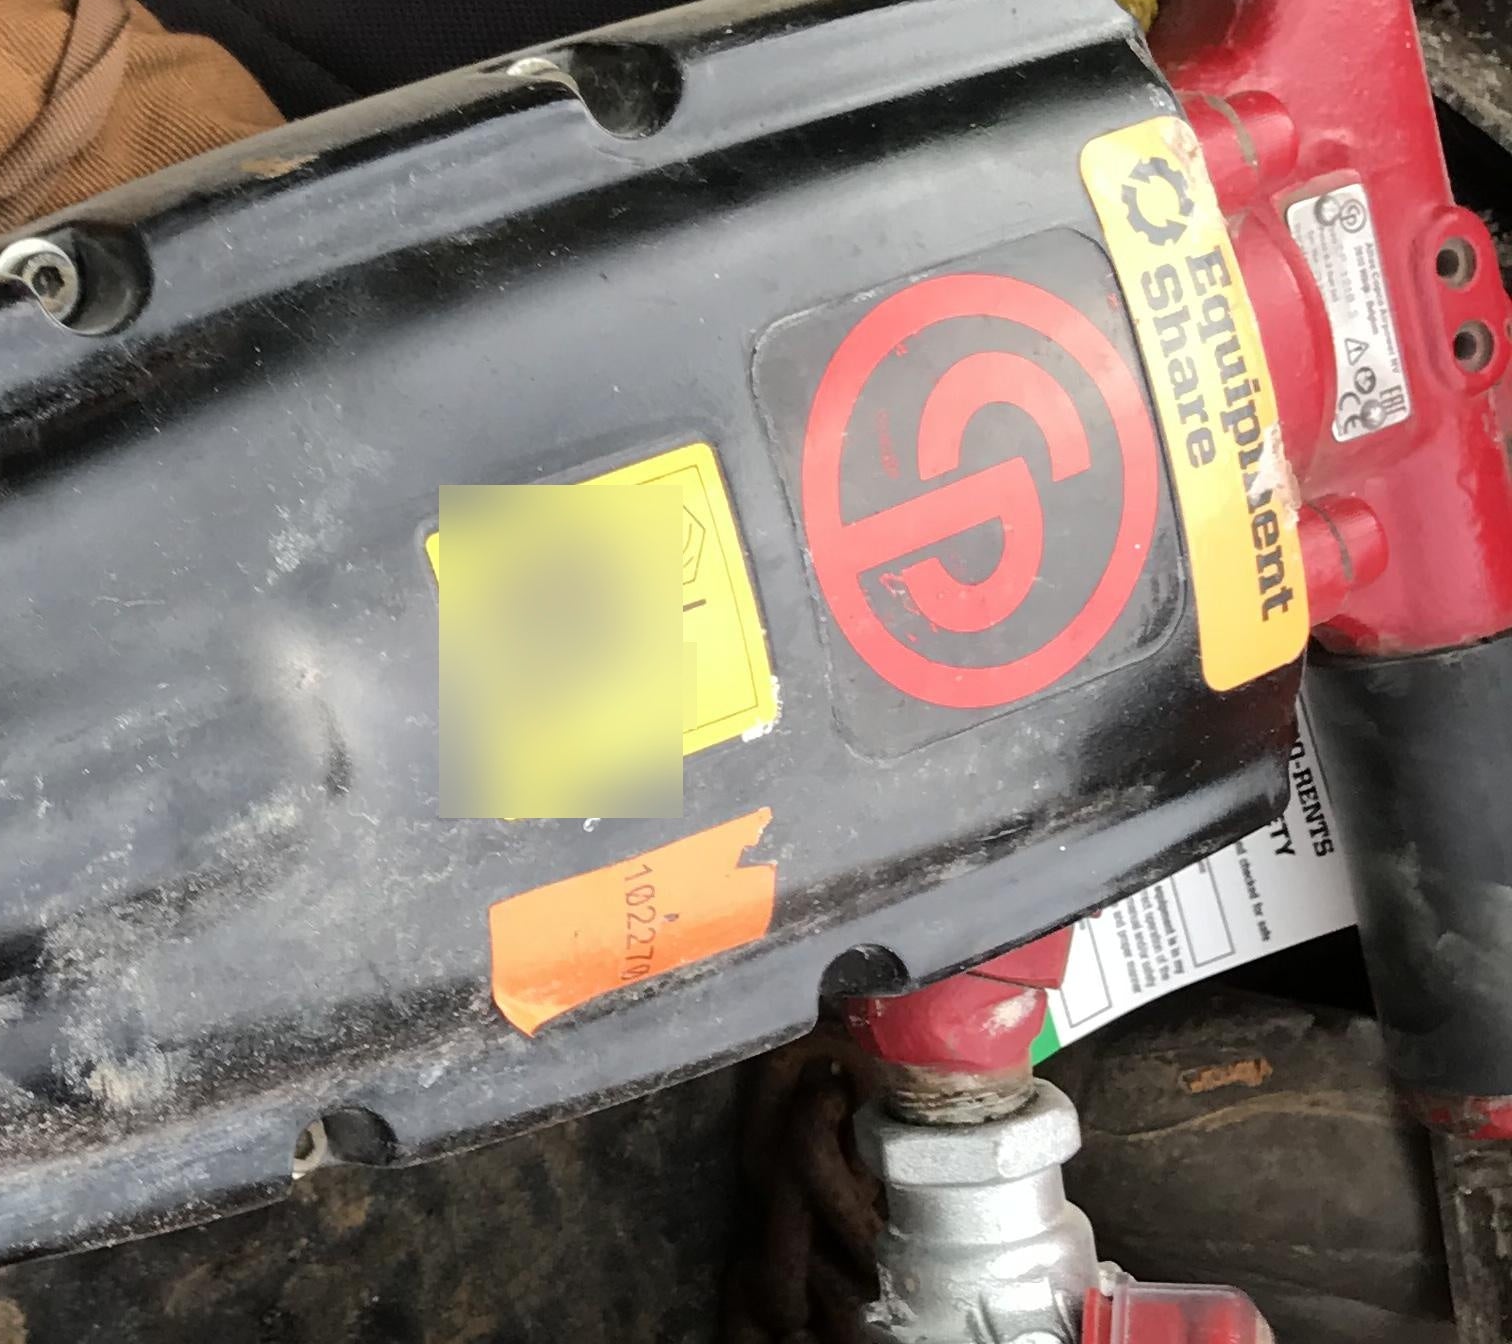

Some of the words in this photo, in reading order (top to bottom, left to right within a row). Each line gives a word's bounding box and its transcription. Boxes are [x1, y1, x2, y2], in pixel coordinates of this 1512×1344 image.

[1140, 262, 1217, 470] Share
[1290, 740, 1335, 858] O-RENTS
[1238, 857, 1260, 899] checked
[1251, 902, 1265, 917] for
